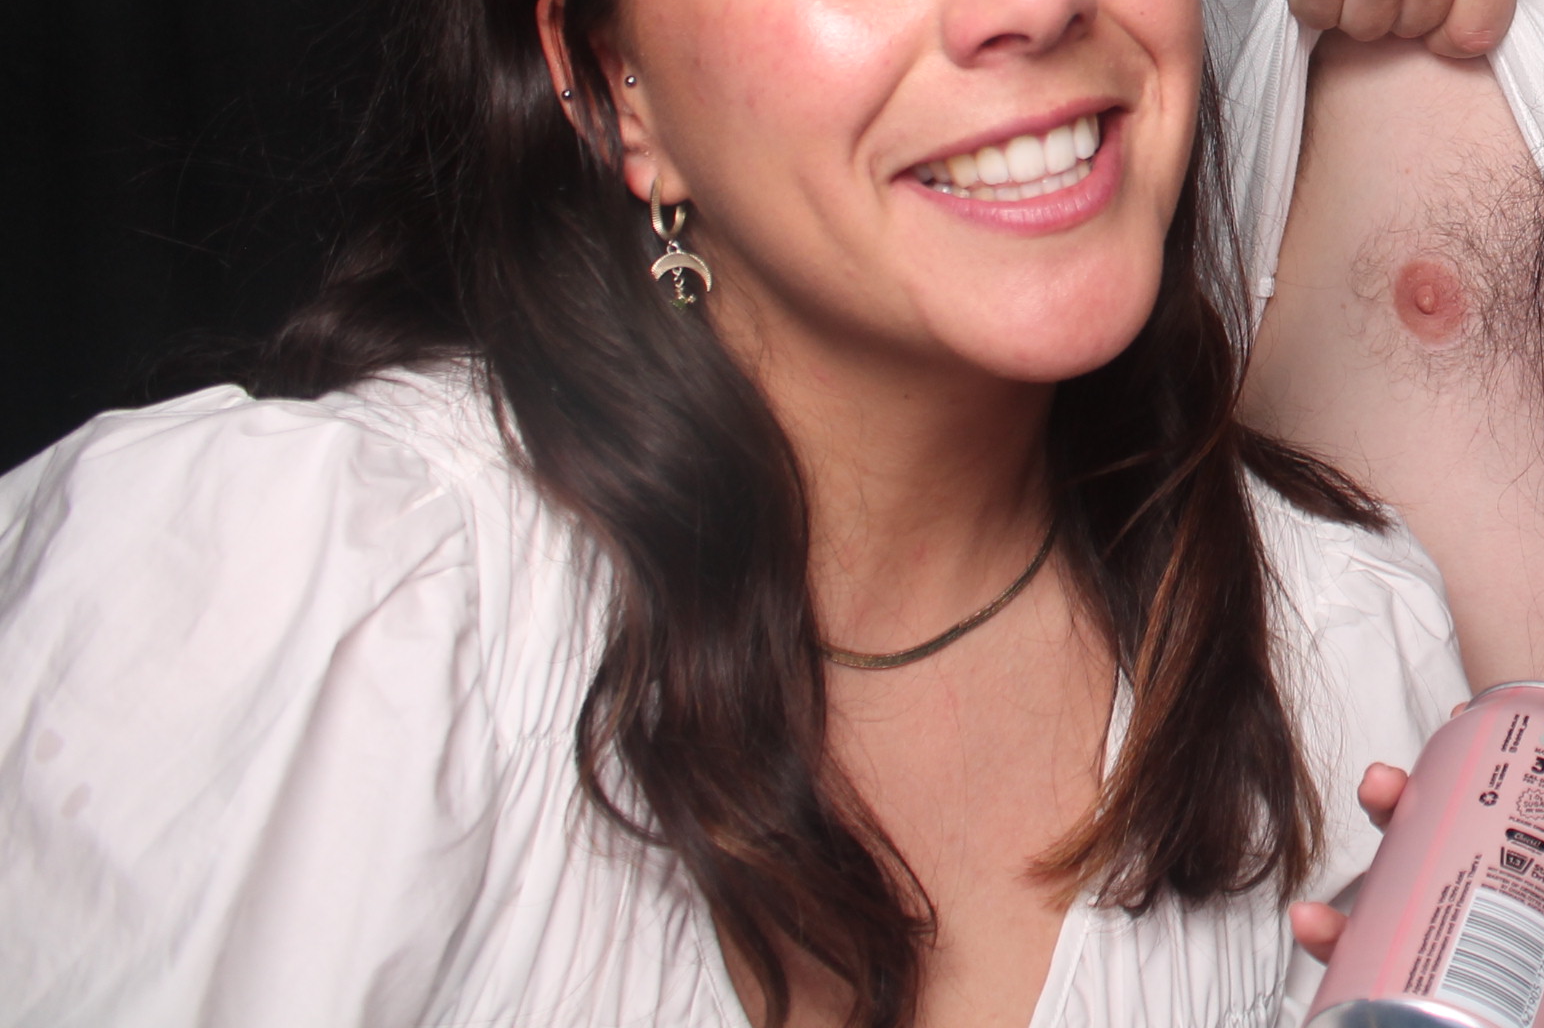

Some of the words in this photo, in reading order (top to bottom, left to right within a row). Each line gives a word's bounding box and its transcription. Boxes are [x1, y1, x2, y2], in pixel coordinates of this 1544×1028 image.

[1508, 816, 1533, 828] PLEASE
[1524, 880, 1535, 888] FOR
[1445, 922, 1455, 935] and
[1427, 941, 1438, 957] from
